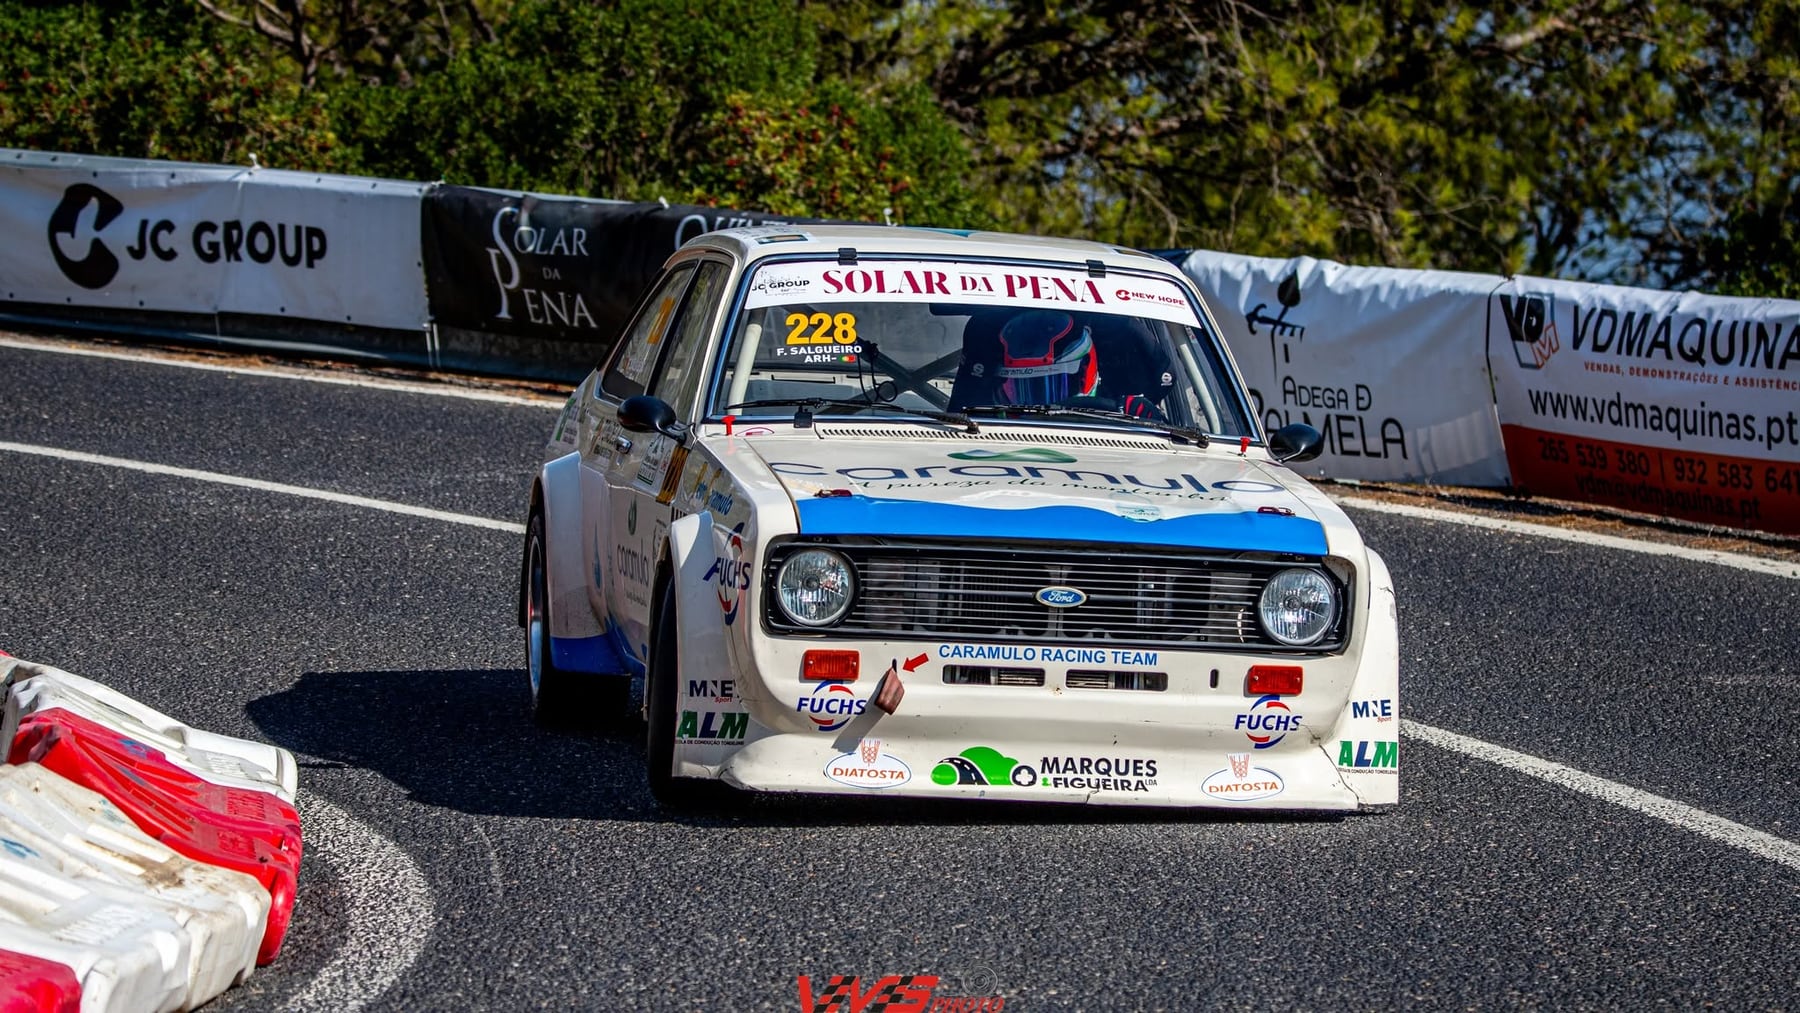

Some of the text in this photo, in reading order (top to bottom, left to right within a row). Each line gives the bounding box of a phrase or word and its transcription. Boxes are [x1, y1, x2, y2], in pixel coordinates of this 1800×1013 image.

[126, 218, 328, 269] JC GROUP
[491, 206, 589, 290] SOLAR
[542, 266, 561, 281] DA
[752, 283, 767, 292] JC
[769, 279, 810, 289] GROUP
[486, 248, 598, 329] PENA
[822, 268, 1107, 305] SOLAR DA PENA
[1131, 291, 1155, 301] NEW
[1158, 295, 1186, 306] HOPE
[785, 311, 857, 345] 228
[776, 345, 862, 356] F. SALGUEIRO
[1583, 361, 1625, 378] VENDAS,
[1628, 365, 1719, 385] DEMONSTRAÇÕES
[1723, 375, 1730, 386] E
[1282, 375, 1349, 411] ADEGA
[1528, 388, 1799, 450] www.vdmaquinas.pt
[1537, 436, 1570, 465] 265
[1576, 442, 1608, 470] 539
[1616, 448, 1650, 477] 380
[1673, 456, 1708, 485] 932
[1717, 463, 1753, 491] 583
[769, 462, 1286, 493] caramulo
[702, 557, 751, 591] FUCHS
[1048, 590, 1075, 603] Ford
[938, 644, 1158, 666] CARAMULO RACING TEAM
[796, 697, 867, 716] FUCHS
[677, 709, 750, 739] ALM
[1234, 714, 1303, 732] FUCHS
[1338, 740, 1398, 769] ALM
[832, 767, 905, 780] DIATOSTA
[1040, 757, 1158, 778] MARQUES
[1052, 777, 1149, 792] FIGUEIRA
[1145, 778, 1158, 787] LDA
[1208, 781, 1279, 793] DIATOSTA
